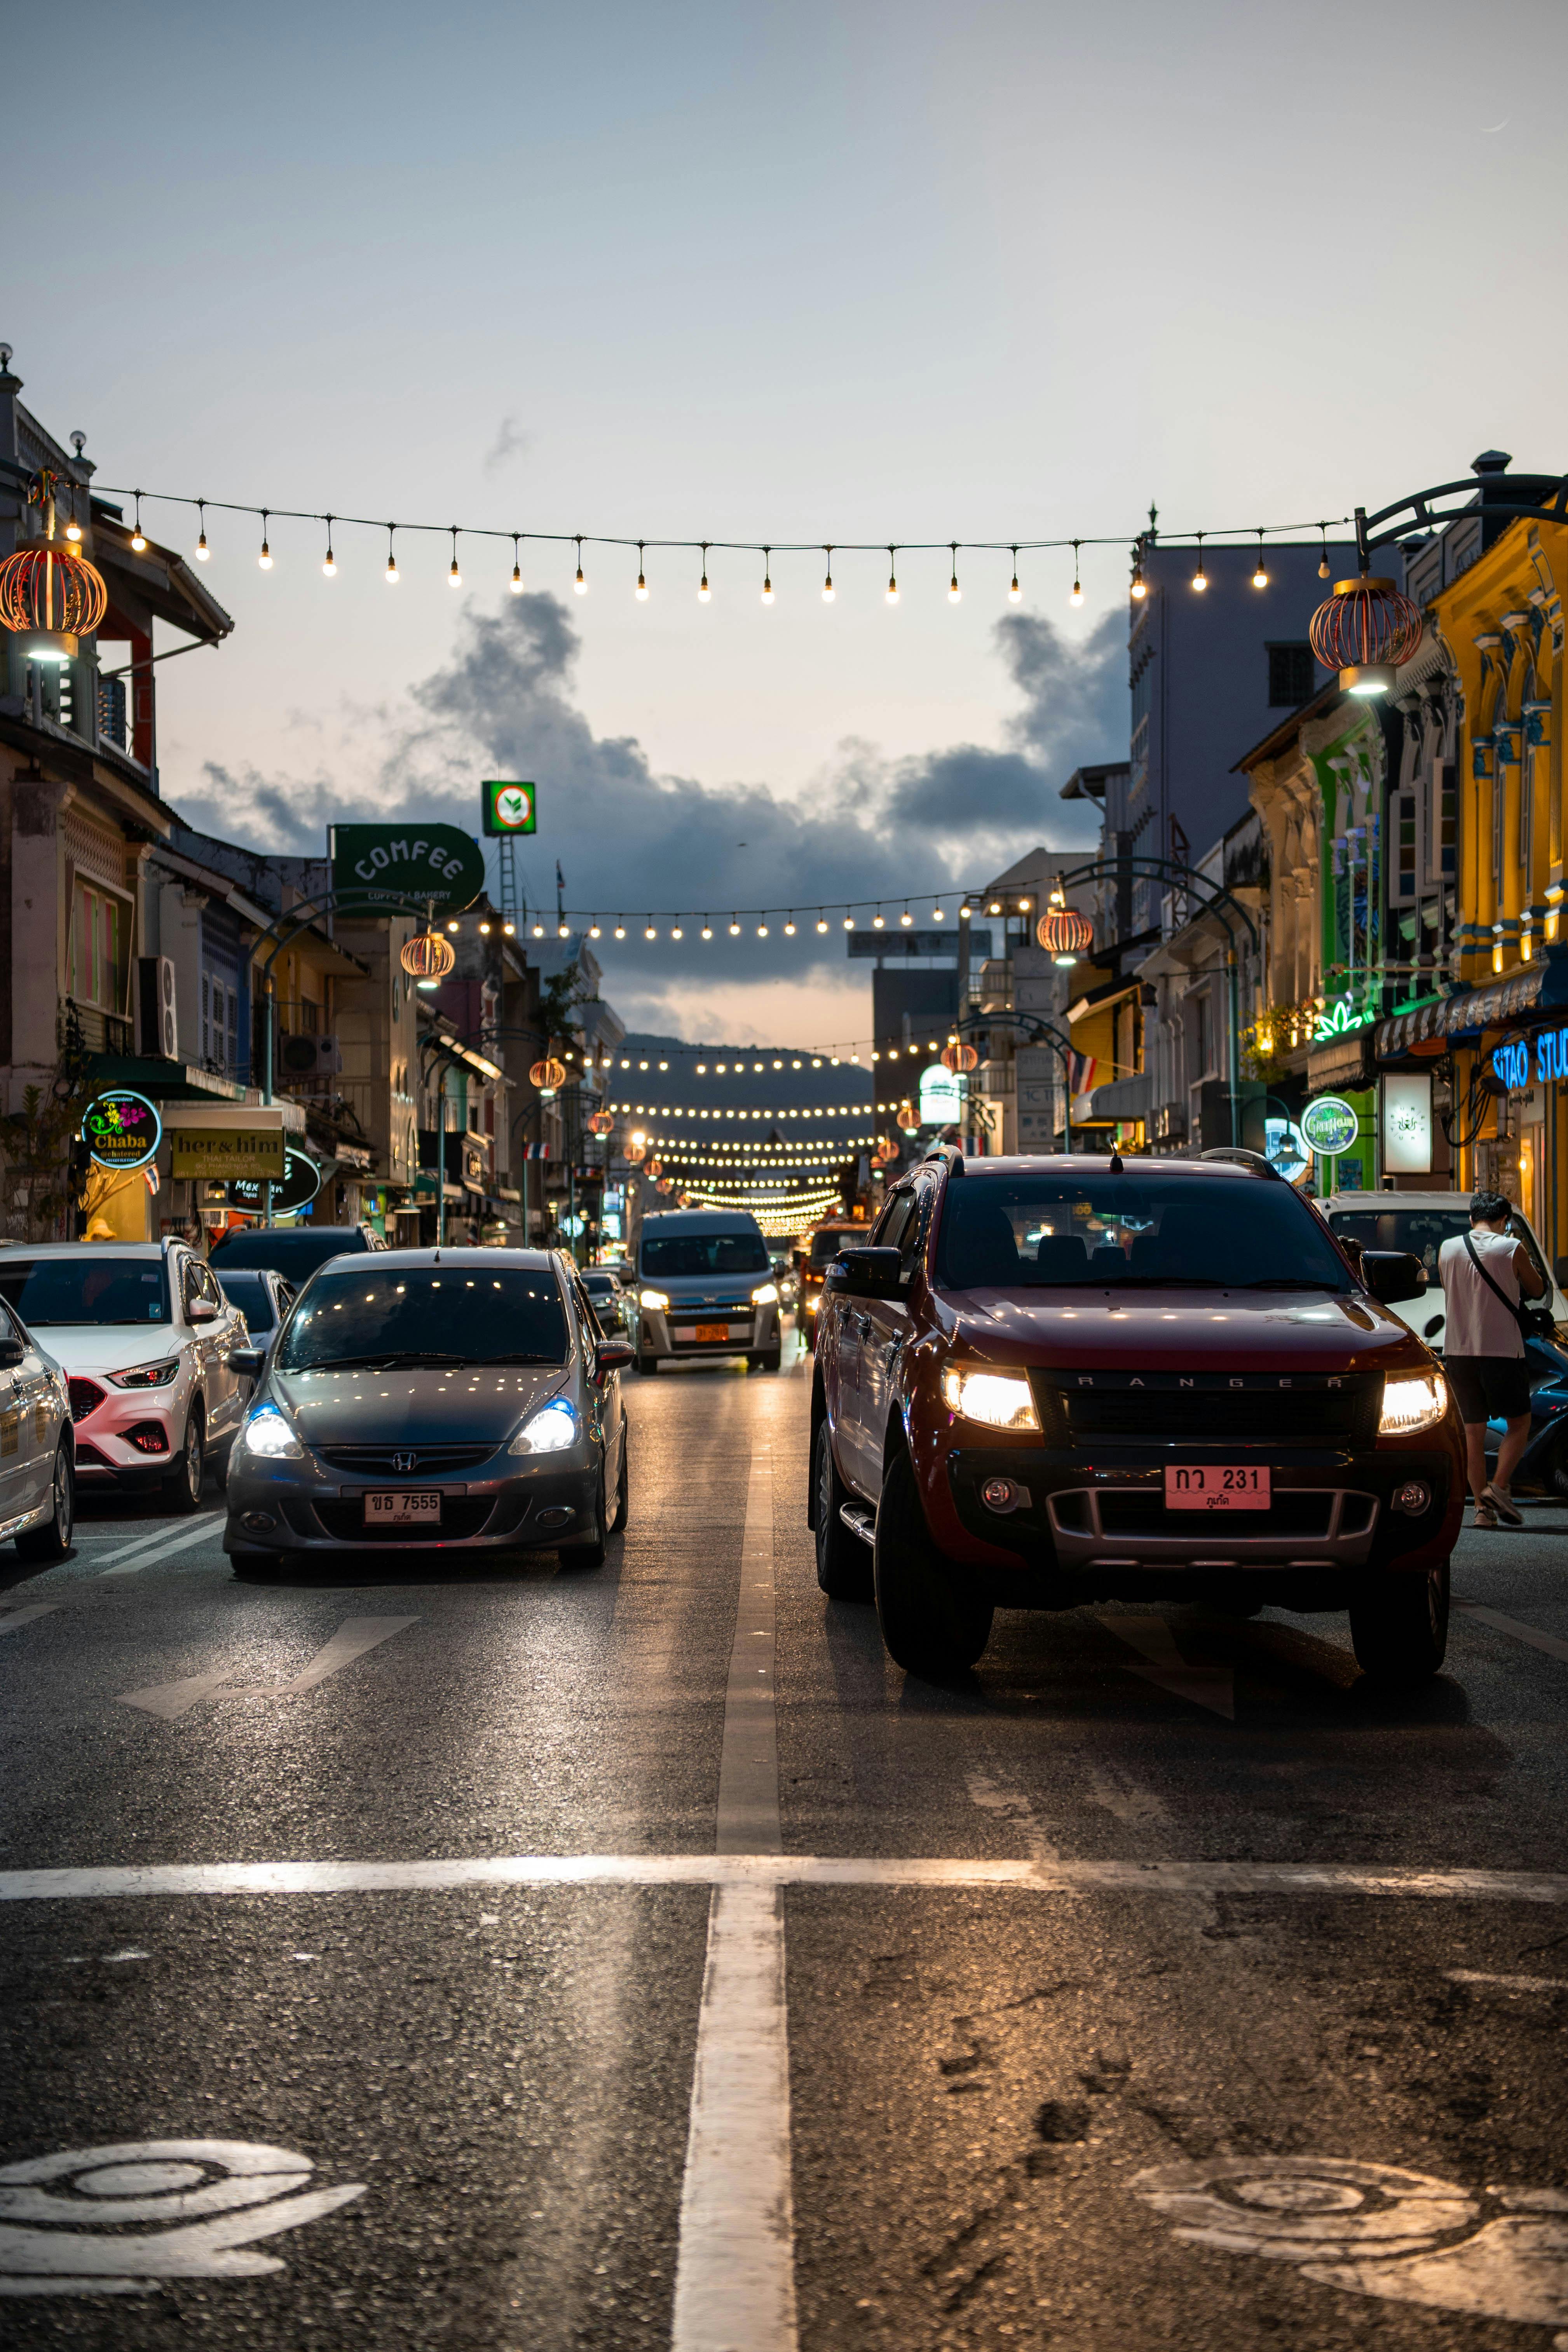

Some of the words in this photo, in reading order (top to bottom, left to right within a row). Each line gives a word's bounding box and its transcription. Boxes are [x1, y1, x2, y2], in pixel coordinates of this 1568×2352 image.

[354, 840, 464, 880] COMFEE
[94, 1134, 148, 1149] Chaba
[235, 1180, 284, 1193] Mexan
[1078, 1376, 1342, 1388] RANGER
[1223, 1469, 1258, 1489] 231
[402, 1495, 438, 1510] 7555
[393, 1512, 412, 1521] ภเก็ต
